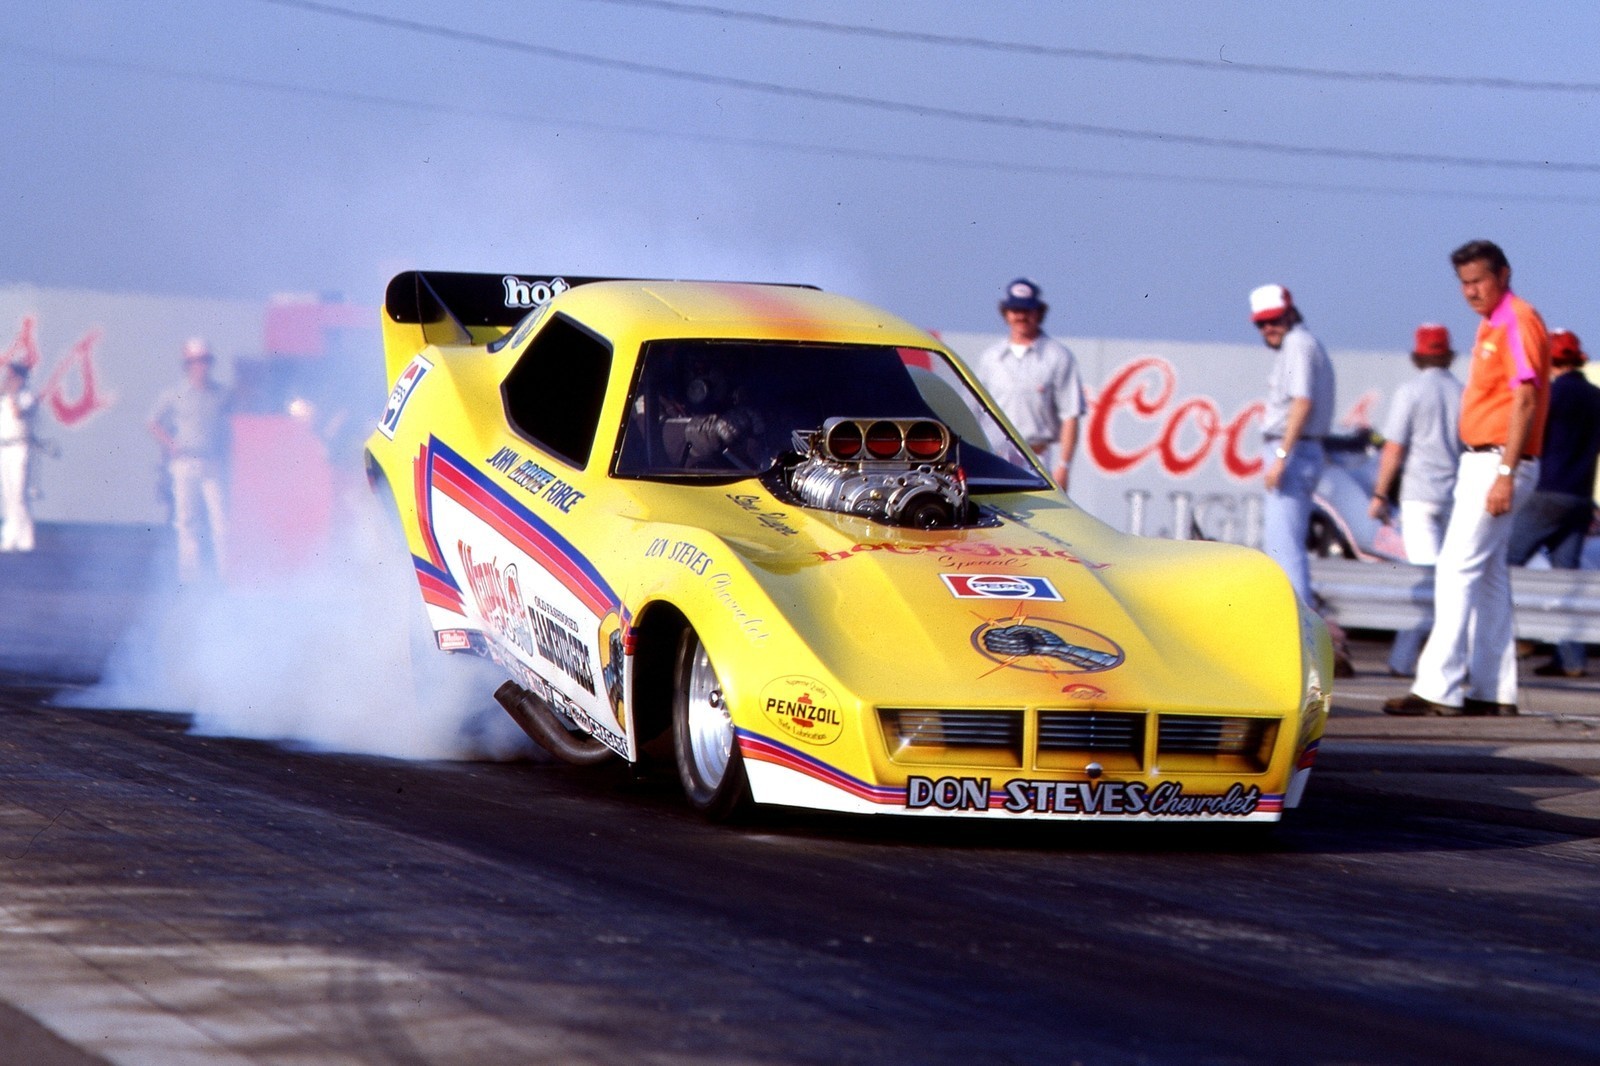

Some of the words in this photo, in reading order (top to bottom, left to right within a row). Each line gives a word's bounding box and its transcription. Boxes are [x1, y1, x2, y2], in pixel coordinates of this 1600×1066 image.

[503, 277, 569, 307] hot
[485, 446, 521, 474] JOHN
[541, 479, 586, 514] FORCE
[668, 541, 714, 576] STEVES
[971, 582, 1030, 592] PEPSI
[766, 697, 840, 726] PENNZOIL
[907, 777, 990, 811] DON
[1003, 780, 1146, 814] STEVES
[1149, 783, 1260, 816] Chevrolet
